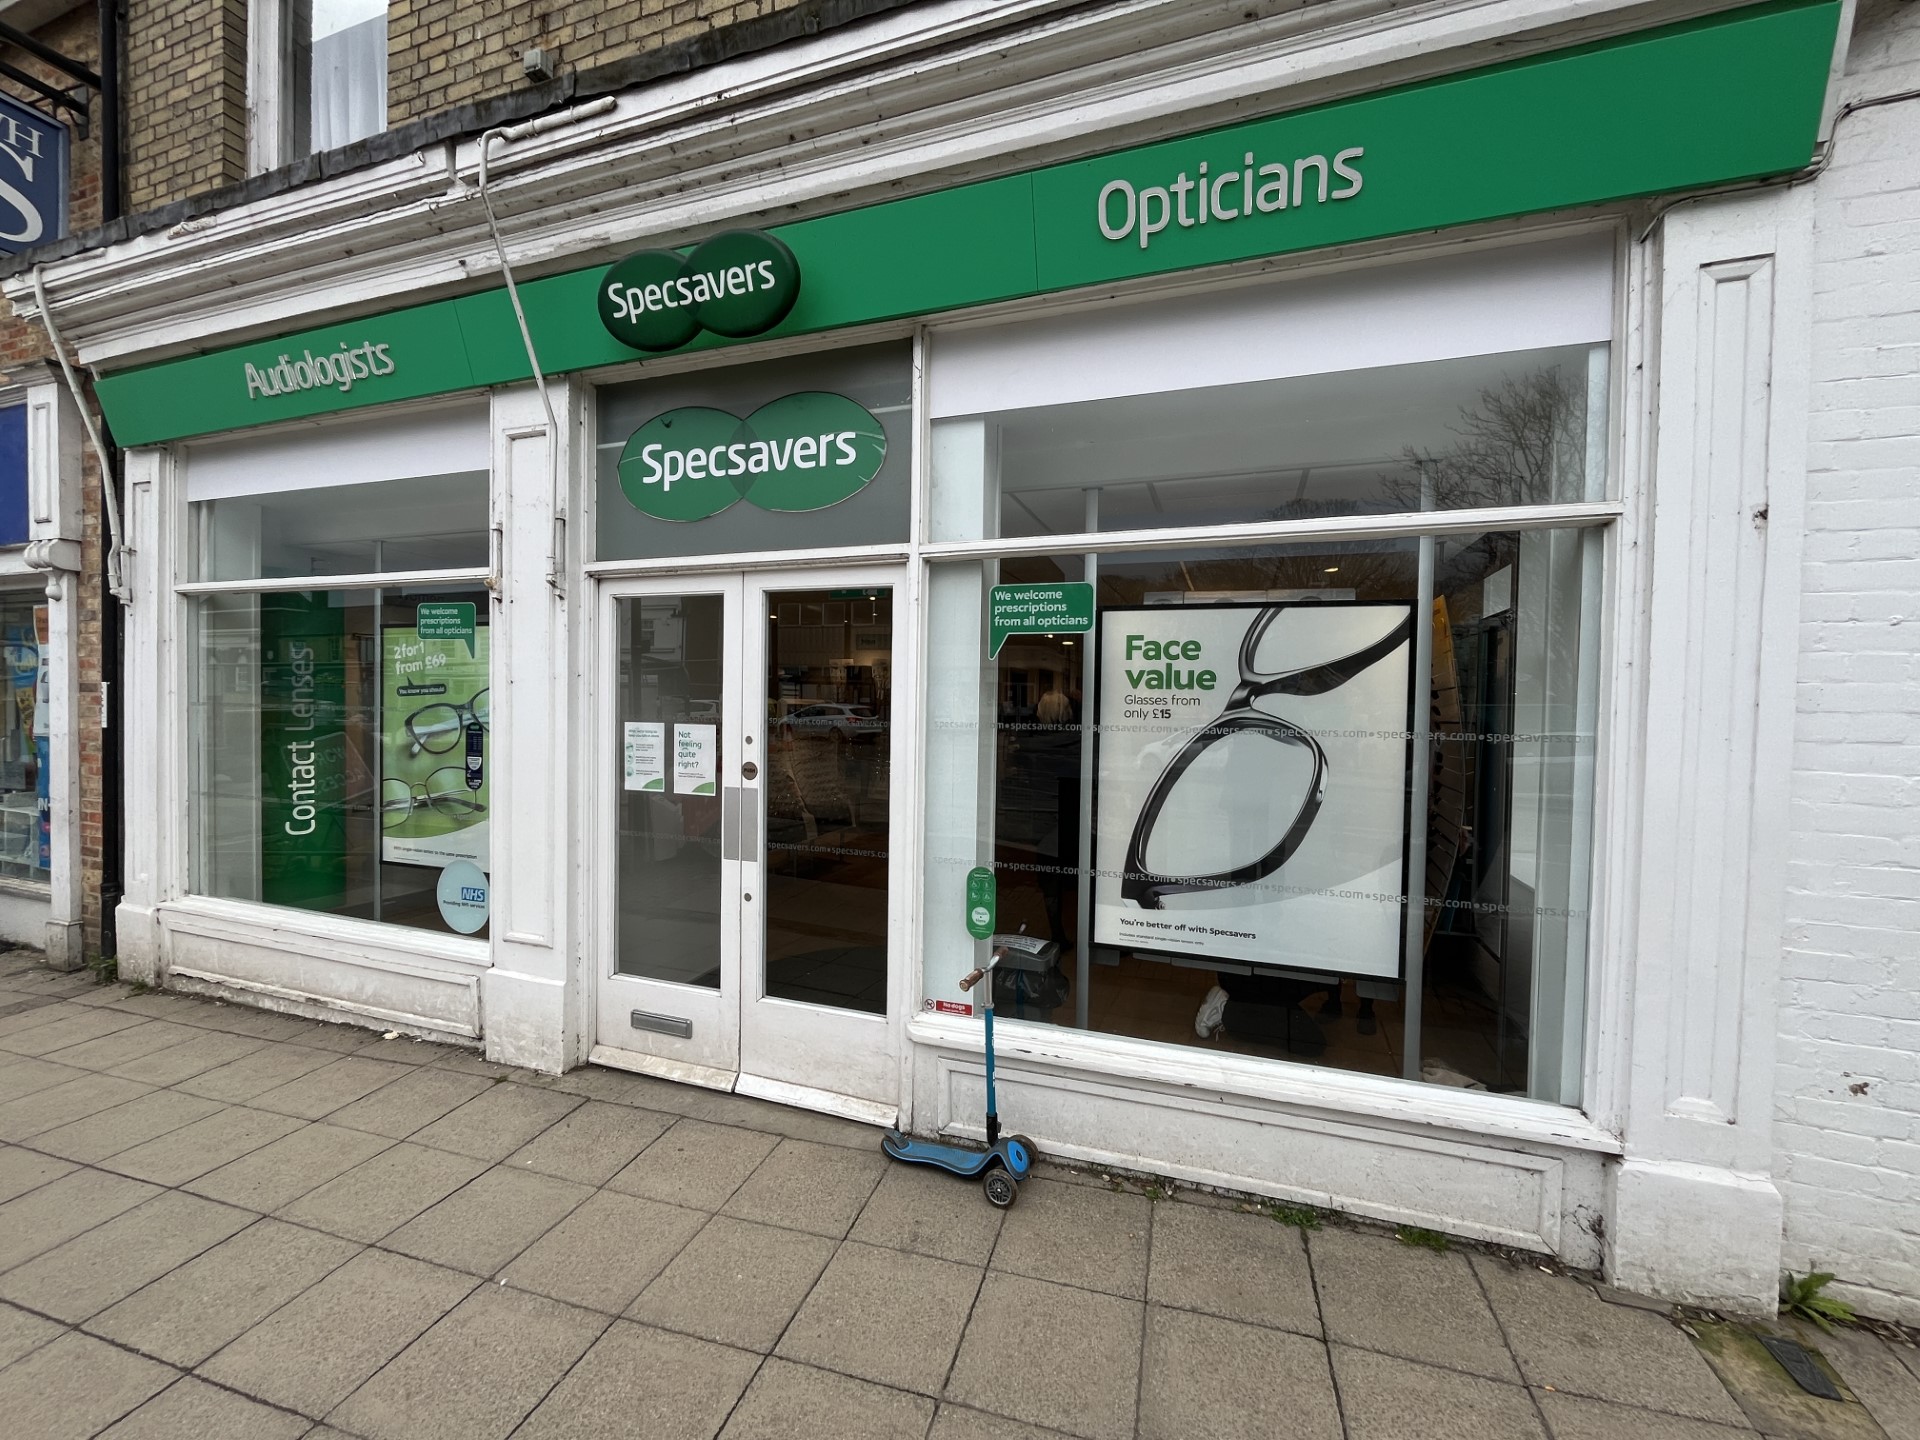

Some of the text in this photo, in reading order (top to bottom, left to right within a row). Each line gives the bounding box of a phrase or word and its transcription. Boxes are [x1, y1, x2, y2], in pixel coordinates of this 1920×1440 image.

[1098, 147, 1364, 249] Opticians
[607, 260, 776, 324] Specsavers
[244, 341, 395, 400] Audiologists
[641, 431, 857, 492] Specsavers
[994, 589, 1063, 600] We welcome
[431, 607, 458, 615] welcome
[994, 602, 1067, 615] prescriptions
[420, 617, 461, 625] prescriptions
[994, 615, 1088, 628] from all opticians
[420, 627, 435, 635] from
[444, 627, 473, 635] opticians
[1125, 634, 1202, 661] Face
[395, 653, 447, 675] from £69
[1124, 662, 1217, 690] value
[1124, 694, 1201, 706] Glasses from
[1123, 708, 1171, 720] only £15
[284, 643, 316, 836] Contact Lenses
[678, 731, 691, 739] Not
[1274, 727, 1368, 739] specsavers.com
[1376, 729, 1477, 742] specsavers.com
[678, 740, 702, 749] feeling
[678, 761, 699, 769] right?
[831, 847, 889, 859] specsavers.co
[1089, 869, 1172, 884] specsavers.com
[1271, 883, 1364, 901] specsavers.com
[462, 888, 485, 901] NHS
[1119, 918, 1144, 927] You're
[1146, 921, 1172, 930] better
[1188, 926, 1208, 934] with
[1209, 927, 1256, 939] Specsavers
